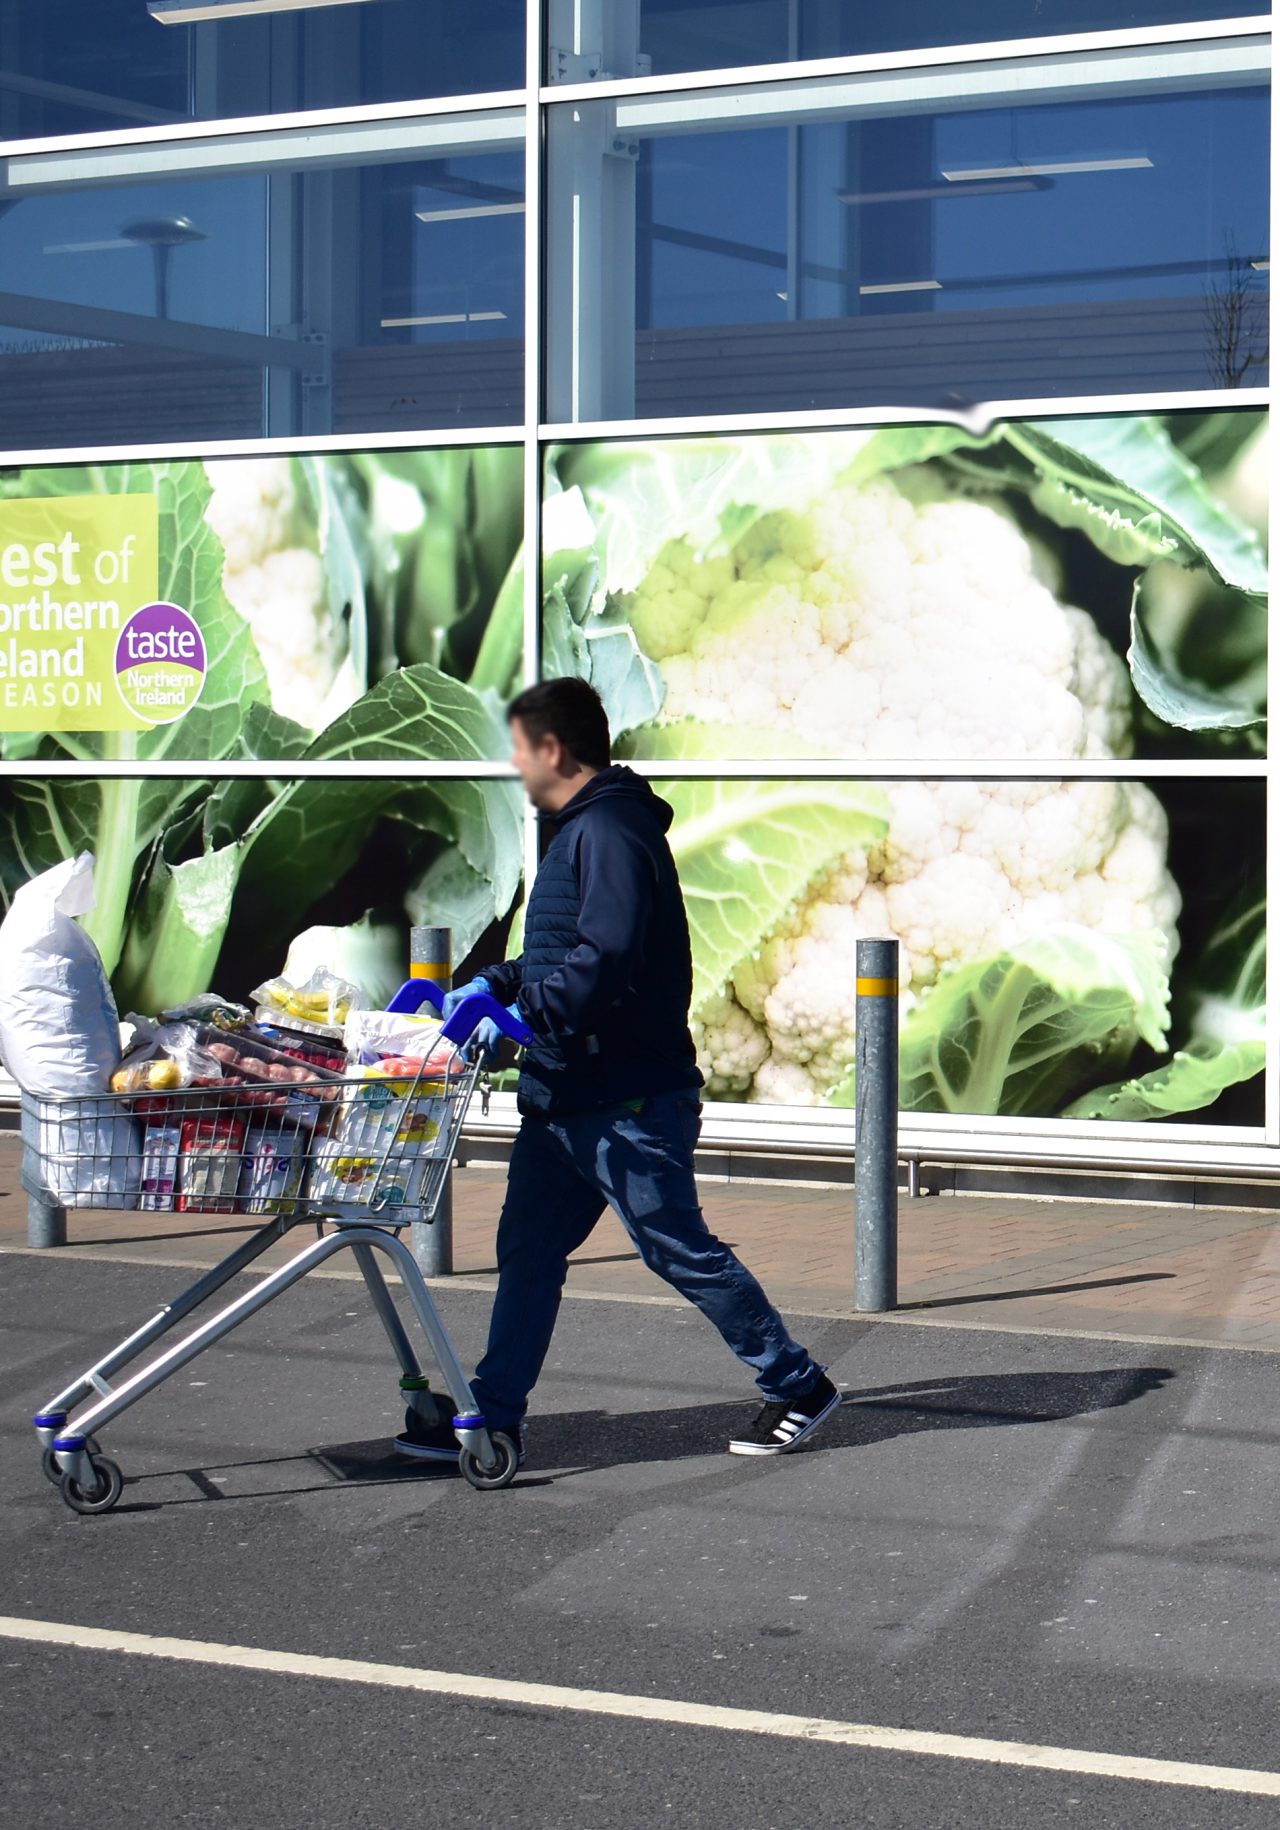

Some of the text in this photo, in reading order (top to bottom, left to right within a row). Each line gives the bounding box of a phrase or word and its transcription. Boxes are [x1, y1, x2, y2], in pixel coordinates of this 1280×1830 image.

[94, 534, 136, 585] of
[127, 625, 195, 659] taste
[127, 670, 194, 688] Northern
[136, 688, 186, 705] Ireland
